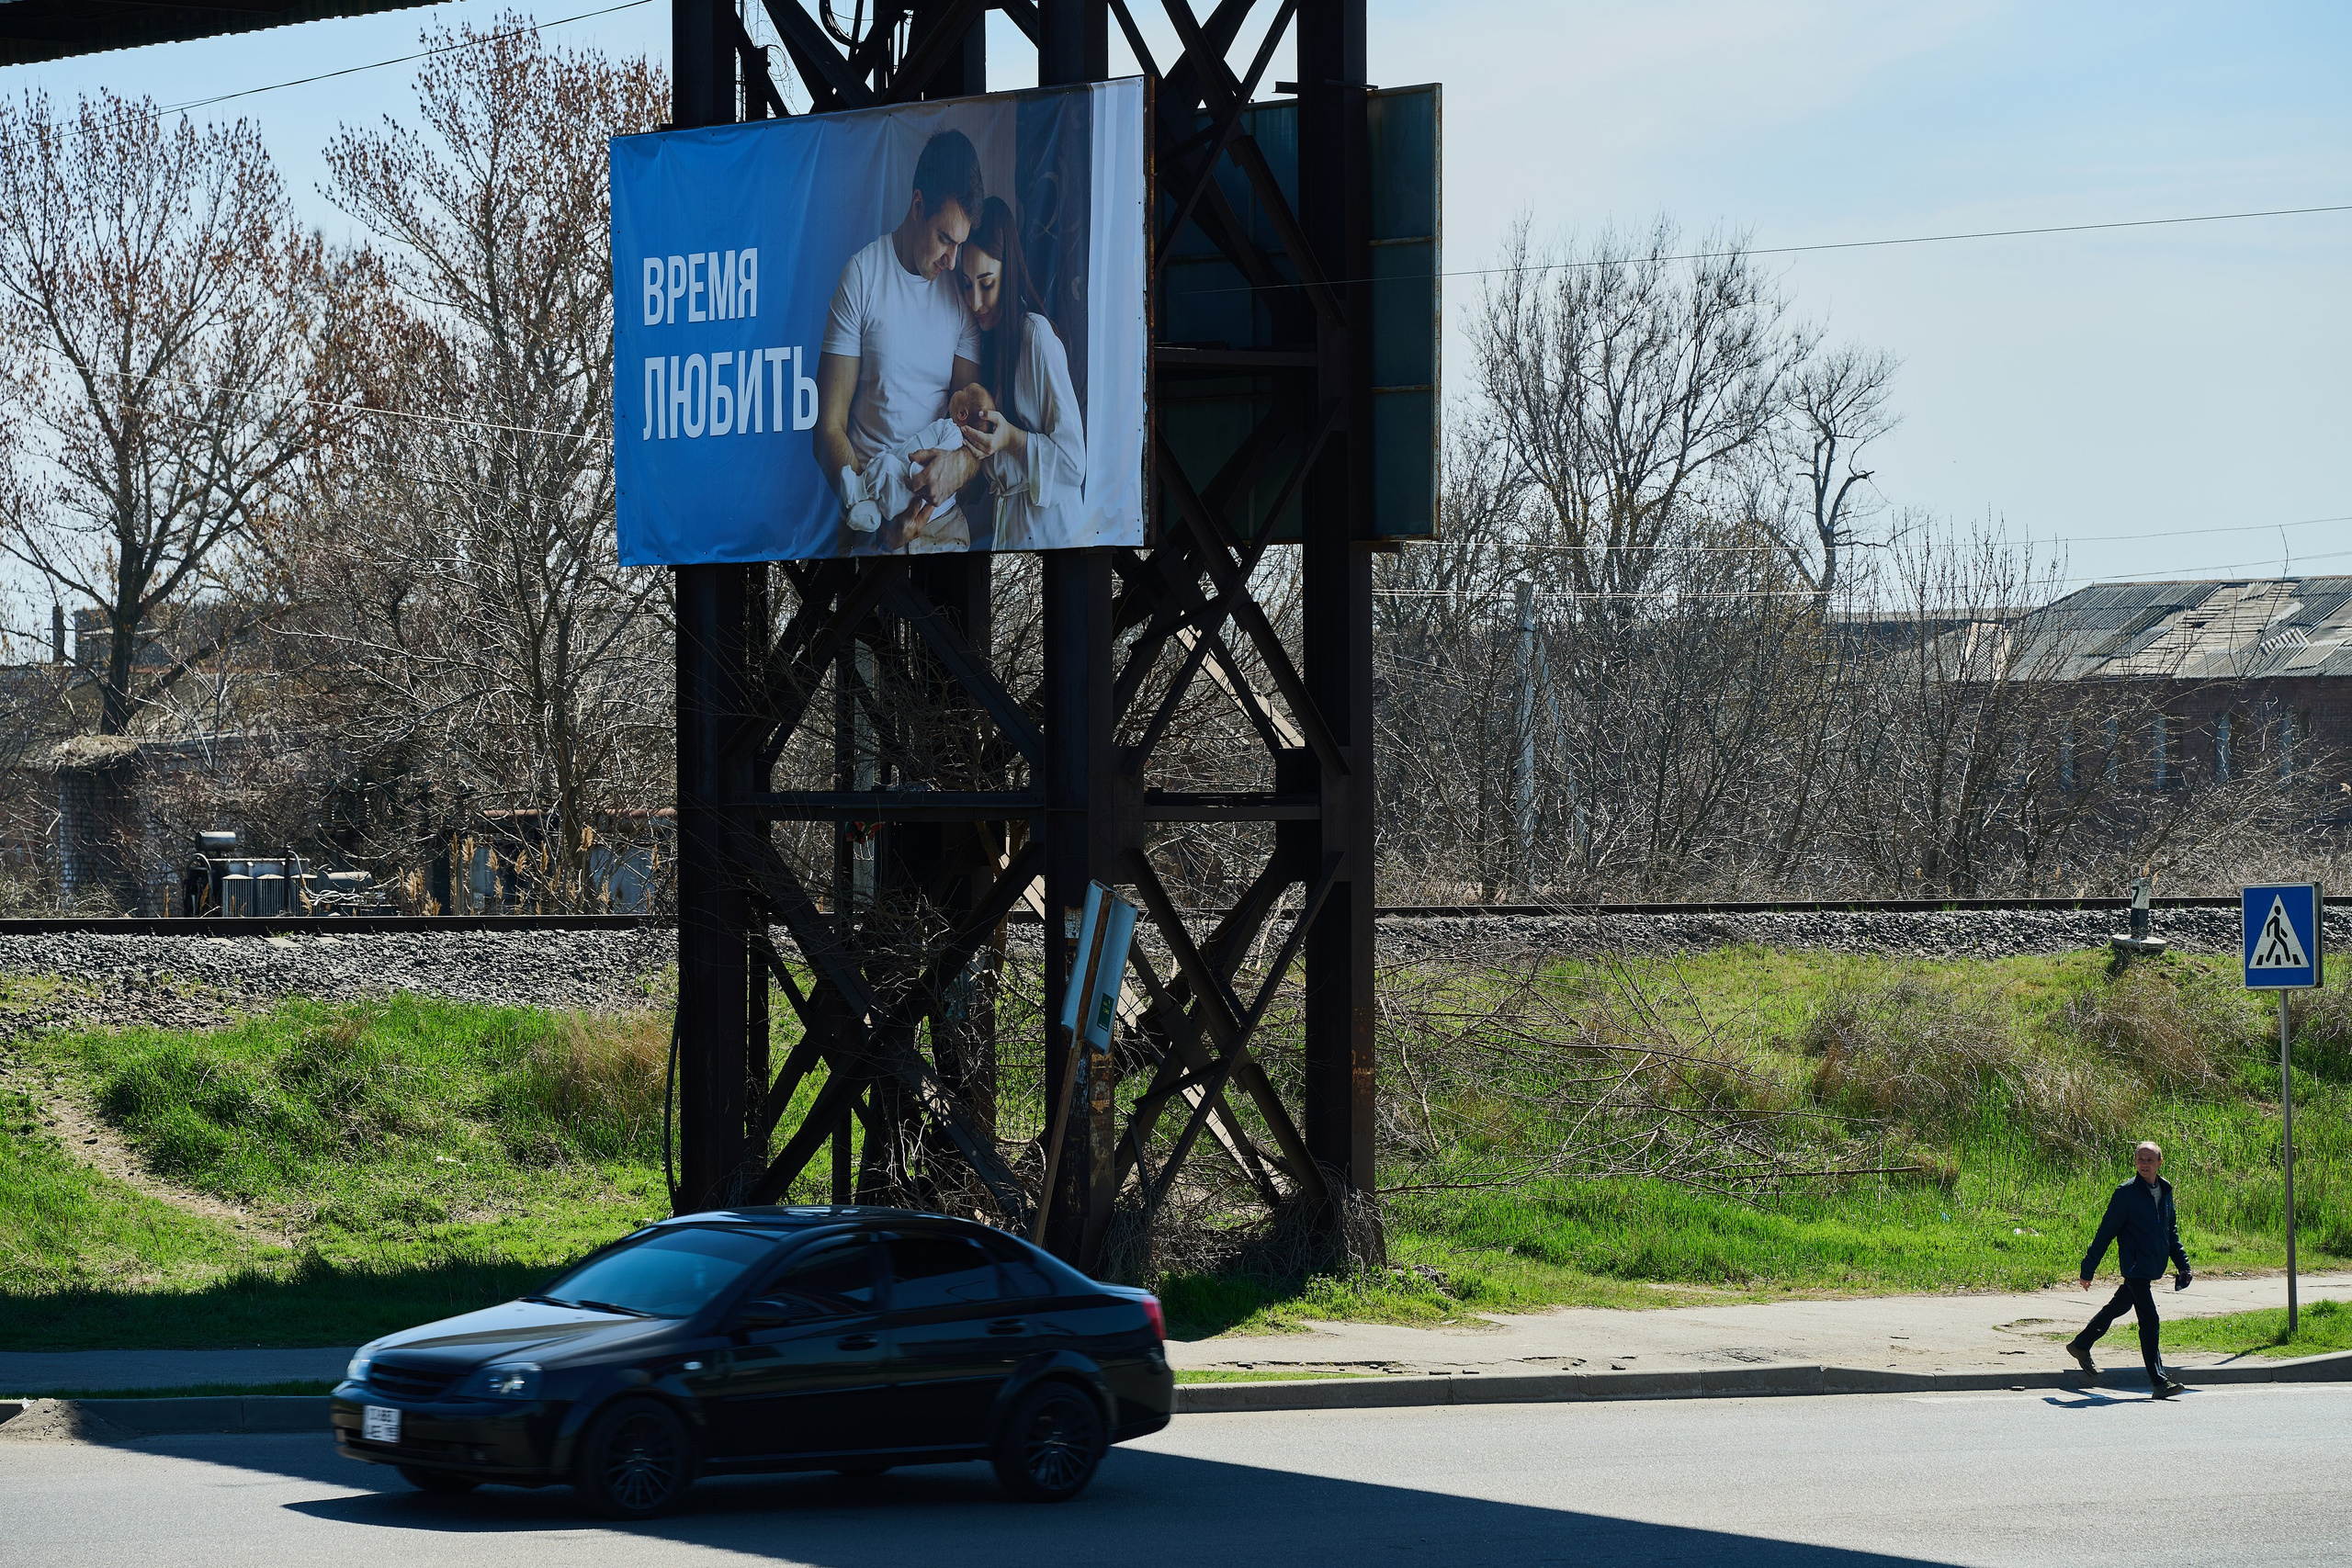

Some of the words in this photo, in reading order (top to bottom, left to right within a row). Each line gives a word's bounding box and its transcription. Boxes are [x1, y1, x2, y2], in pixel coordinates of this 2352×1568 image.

[643, 247, 758, 326] ВРЕМЯ
[643, 345, 819, 441] ЛЮБИТЬ
[2132, 886, 2140, 905] 7
